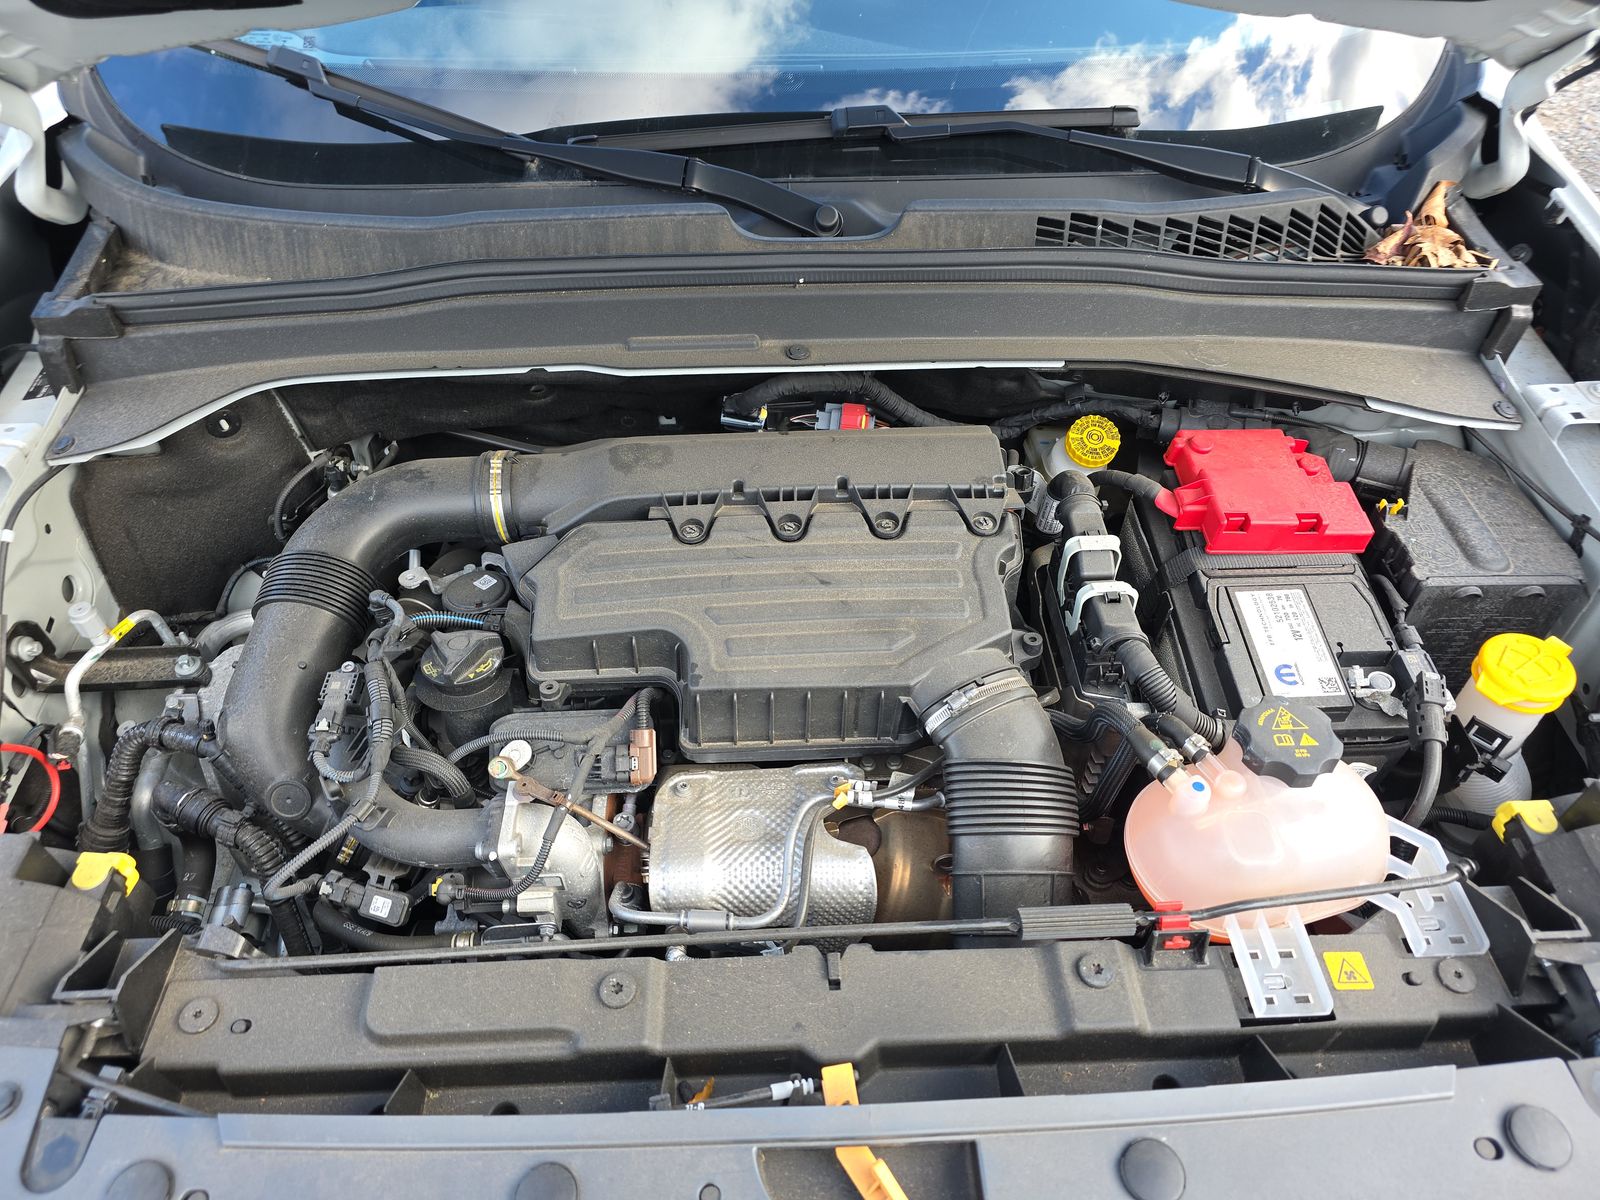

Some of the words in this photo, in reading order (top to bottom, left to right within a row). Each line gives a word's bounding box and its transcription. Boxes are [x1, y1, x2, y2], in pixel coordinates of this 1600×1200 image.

[1251, 593, 1270, 633] TECHNOLOGY
[1290, 629, 1304, 641] 12V
[182, 872, 197, 882] 27
